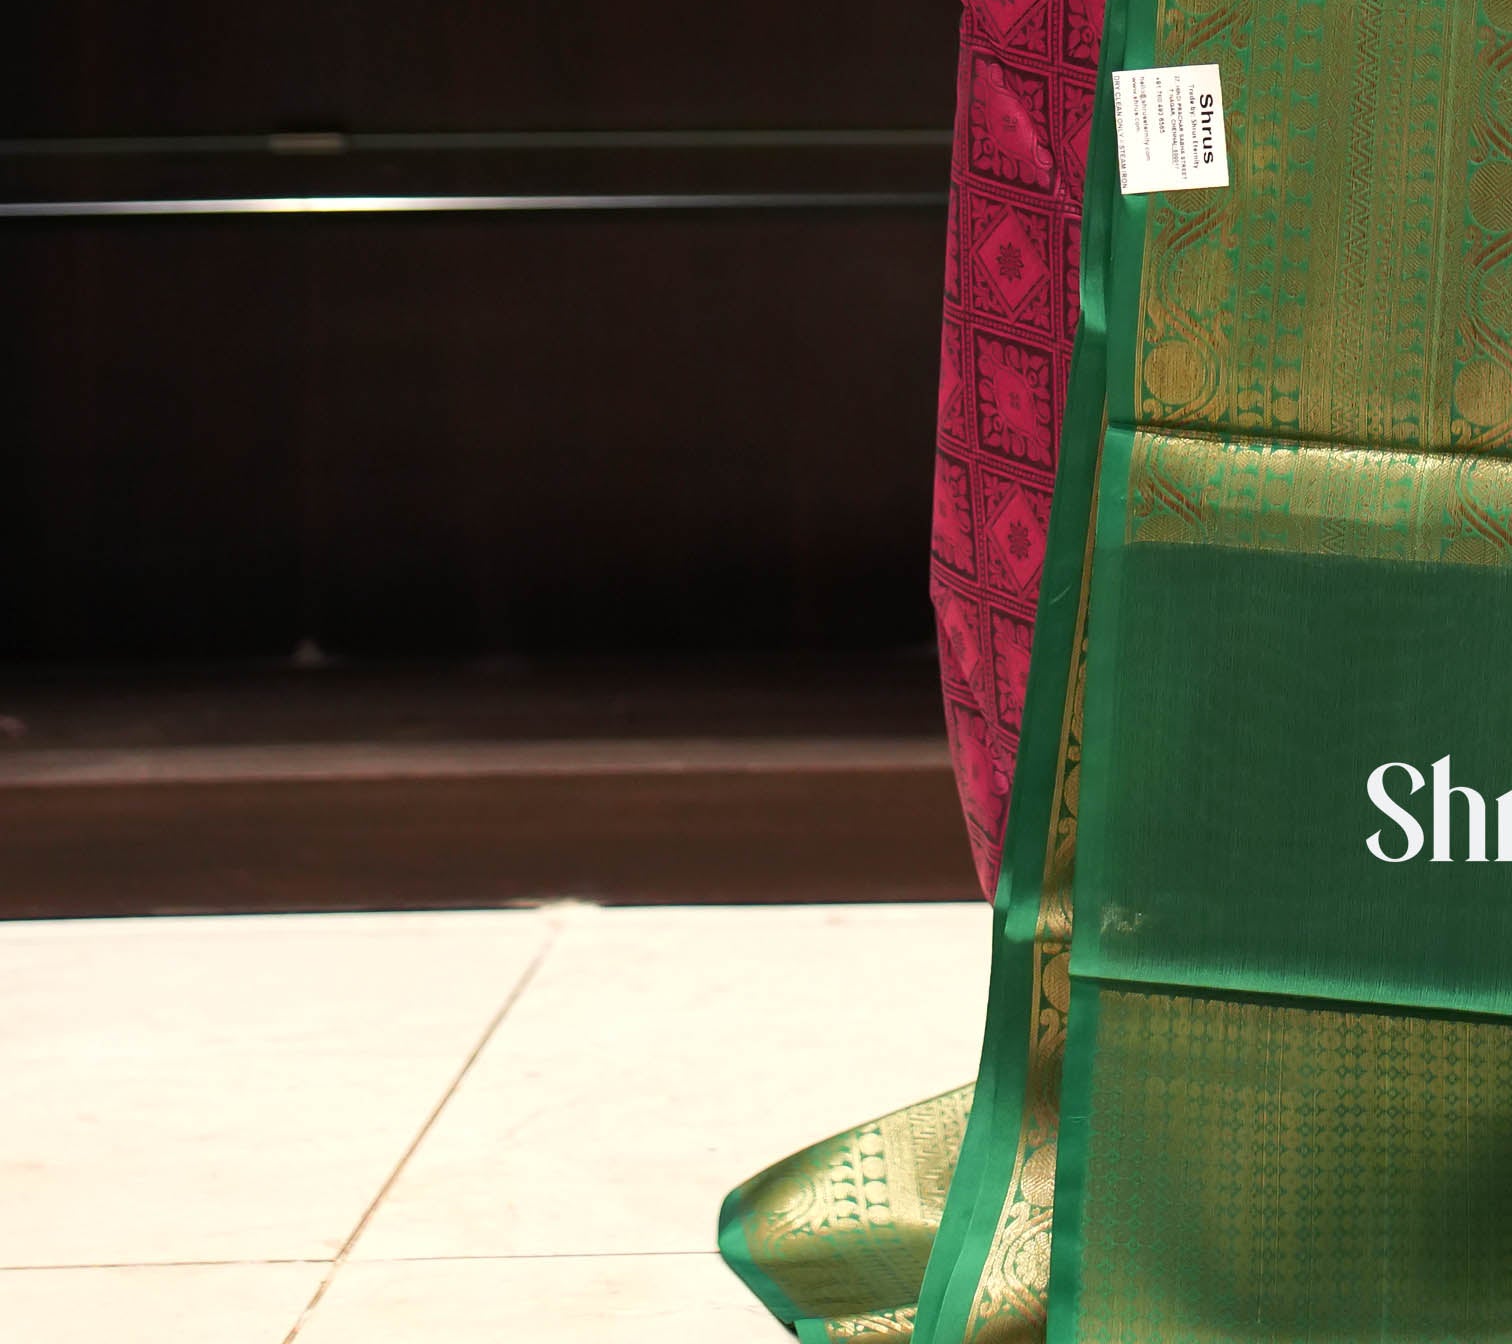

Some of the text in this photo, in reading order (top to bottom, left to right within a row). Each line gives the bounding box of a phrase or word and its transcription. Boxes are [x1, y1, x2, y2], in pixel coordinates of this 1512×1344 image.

[1115, 91, 1123, 116] CLEAN
[1117, 118, 1125, 137] ONLY
[1191, 119, 1199, 138] Shrus
[1199, 94, 1214, 164] Shrus
[1120, 145, 1128, 168] STEAM
[1192, 140, 1200, 168] Eternity
[1121, 170, 1129, 188] IRON
